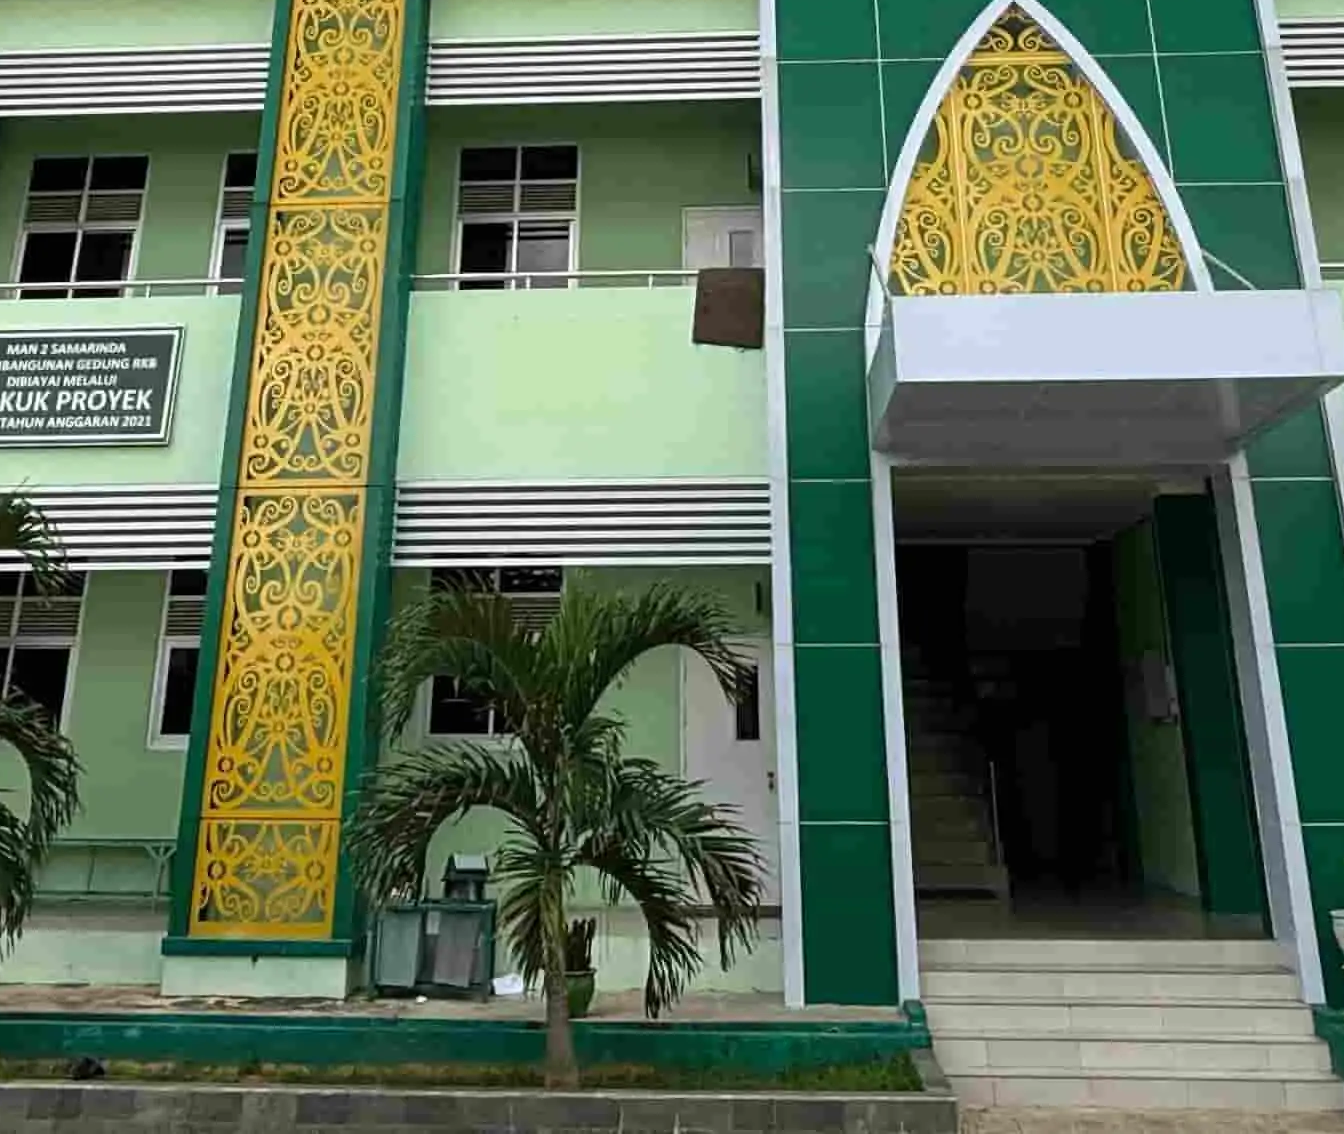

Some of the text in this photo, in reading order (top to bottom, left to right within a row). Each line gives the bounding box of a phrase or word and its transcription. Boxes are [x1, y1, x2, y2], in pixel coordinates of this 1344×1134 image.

[7, 342, 126, 355] MAN 2 SAMARINDA
[77, 358, 129, 370] GEDUNG
[7, 374, 118, 388] DIBIAYAI MELALUI
[56, 389, 153, 411] PROYEK
[0, 417, 45, 429] TAHUN
[47, 416, 118, 429] ANGGARAN
[122, 415, 152, 427] 2021
